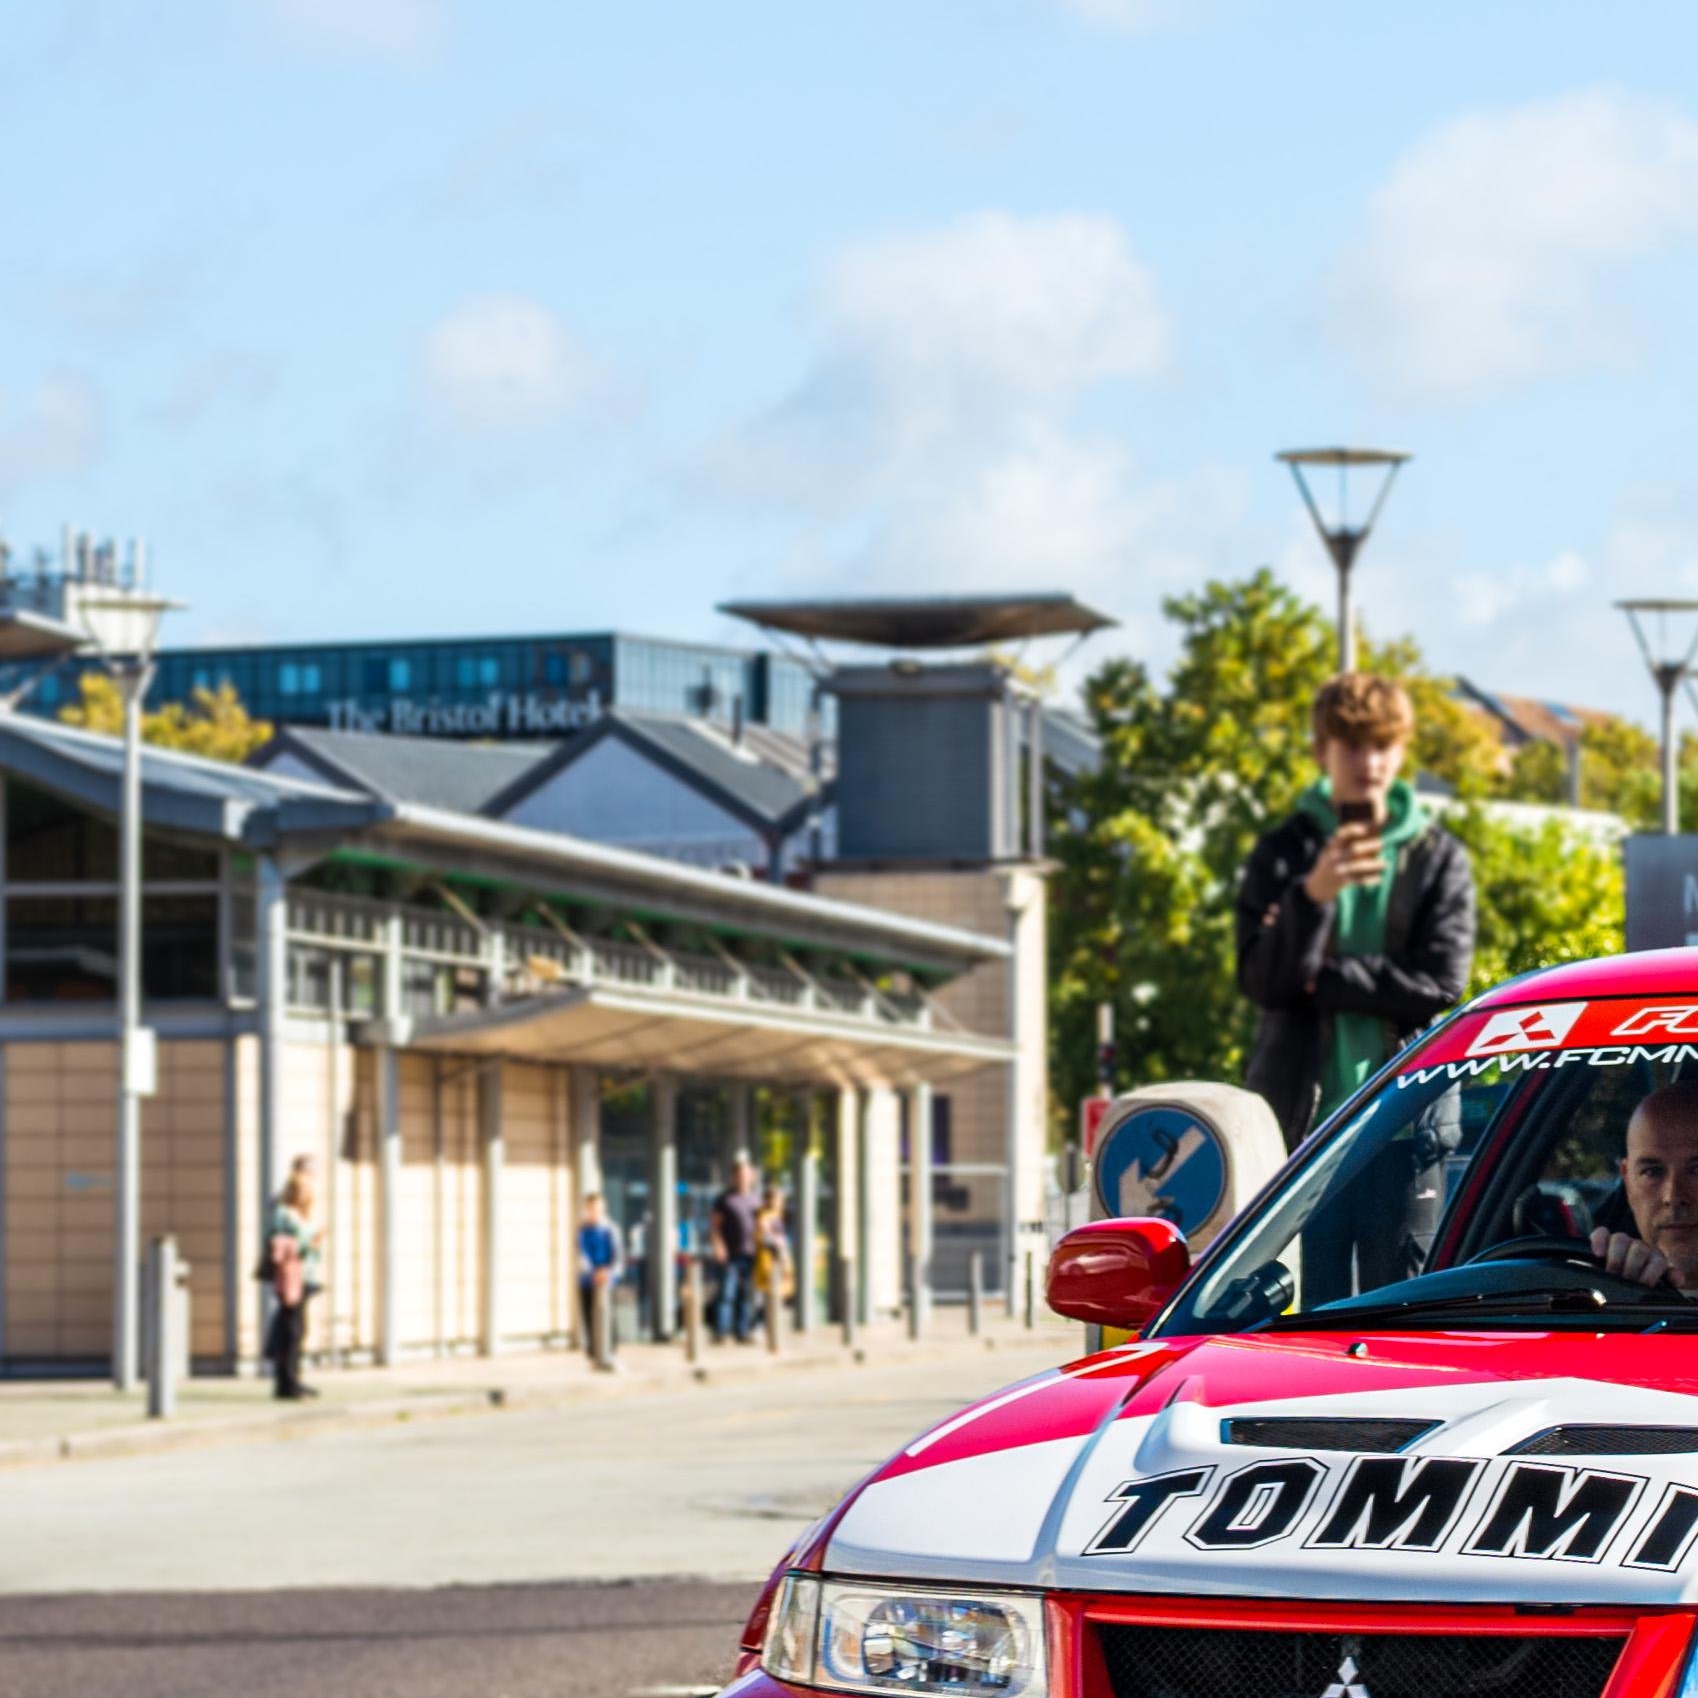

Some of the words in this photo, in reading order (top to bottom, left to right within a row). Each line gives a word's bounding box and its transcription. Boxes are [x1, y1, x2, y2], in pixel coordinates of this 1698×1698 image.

[329, 697, 384, 732] The
[391, 692, 497, 734] Bristol
[508, 689, 602, 731] Hotel
